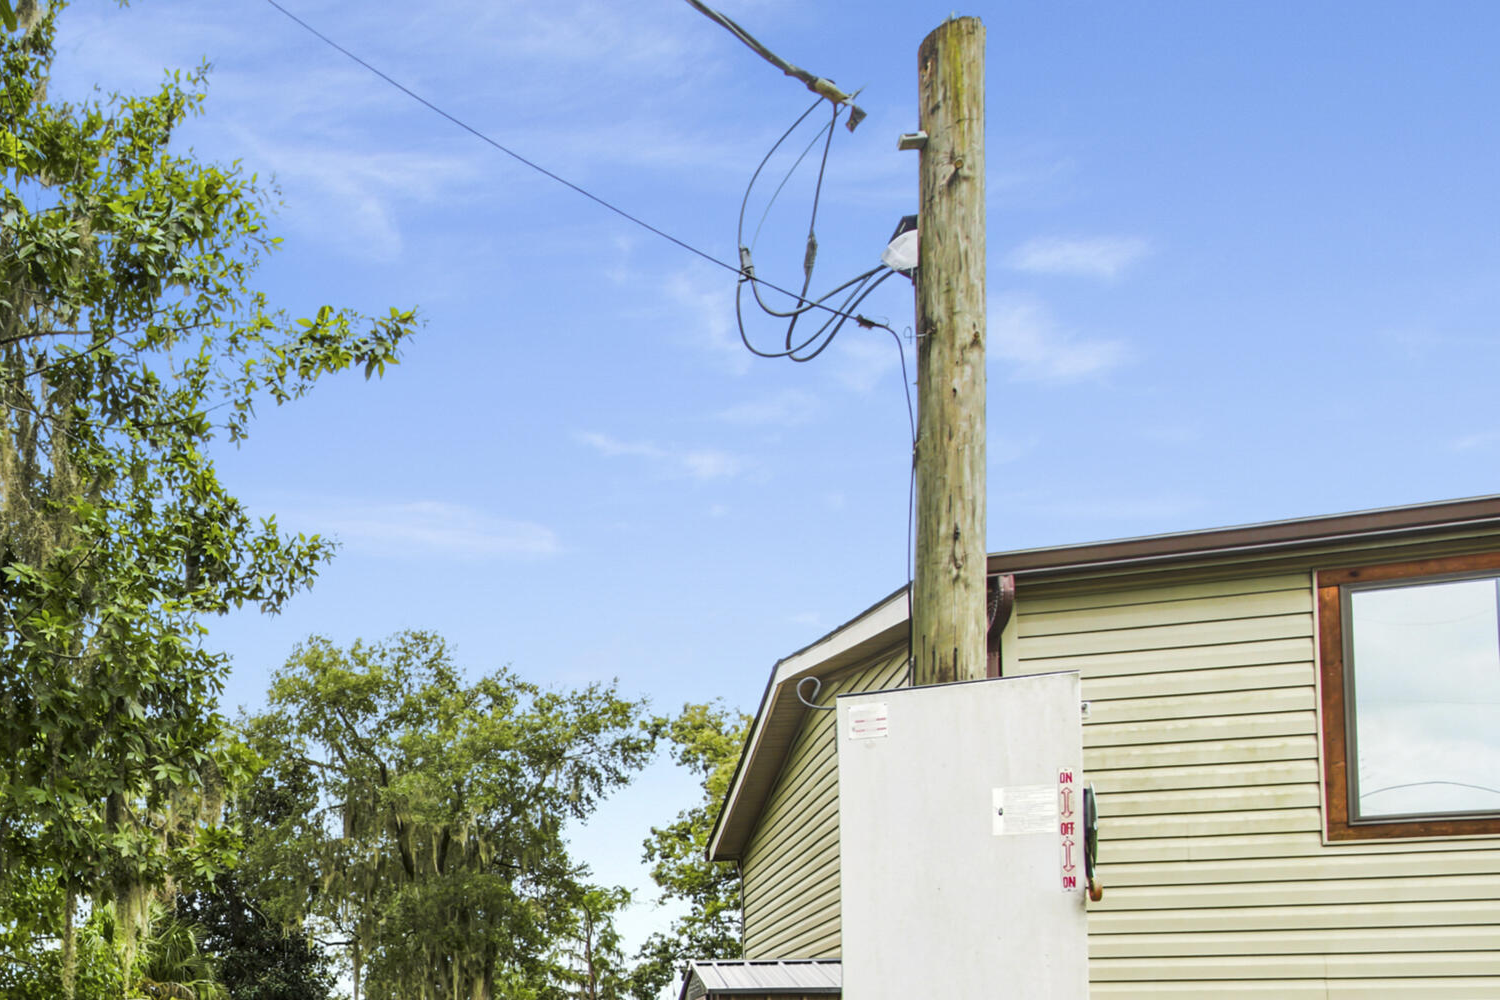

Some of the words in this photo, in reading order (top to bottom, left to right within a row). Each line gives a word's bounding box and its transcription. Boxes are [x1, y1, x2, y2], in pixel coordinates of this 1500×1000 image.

[1059, 771, 1073, 783] ON
[1061, 822, 1074, 835] OFF
[1063, 876, 1076, 888] ON
